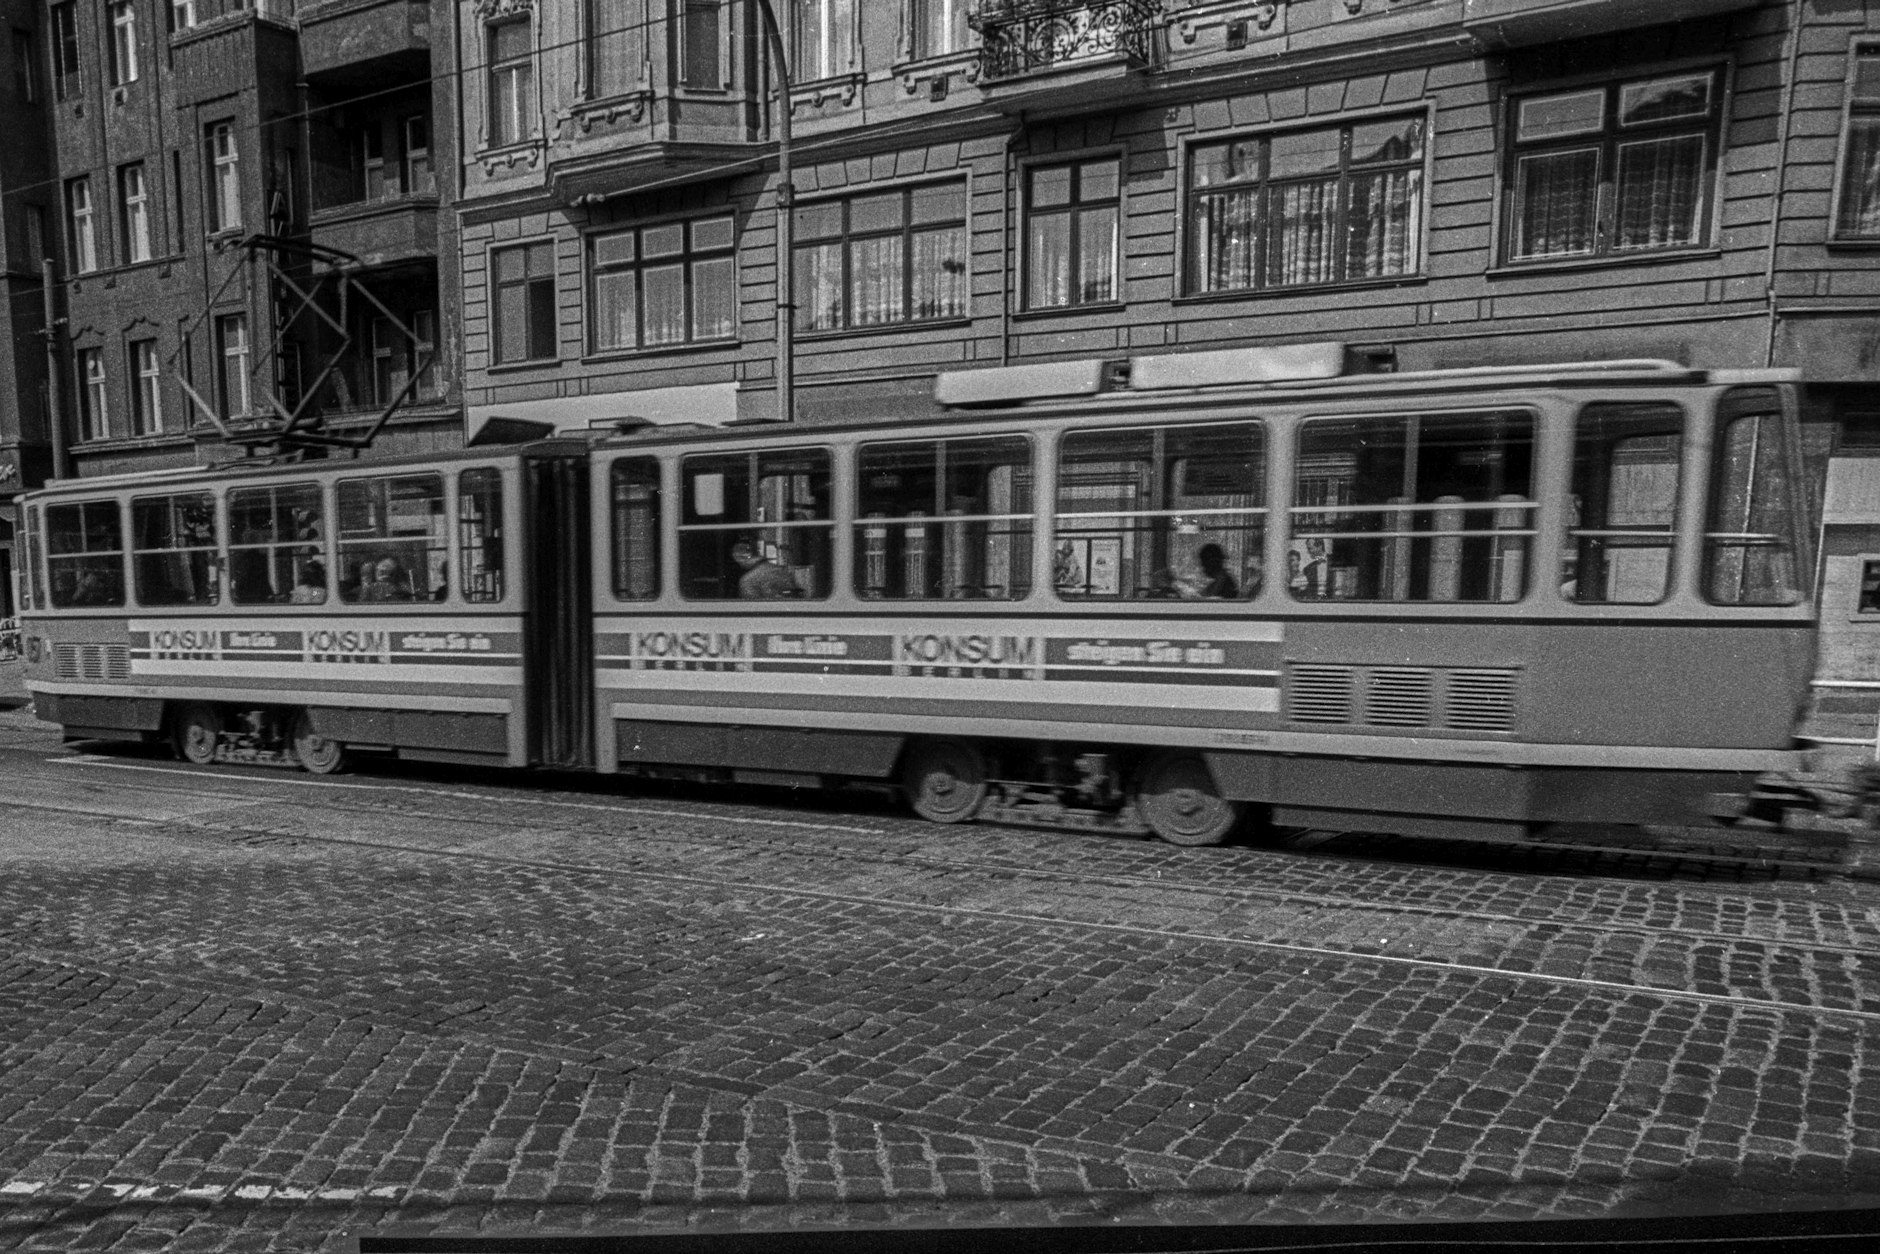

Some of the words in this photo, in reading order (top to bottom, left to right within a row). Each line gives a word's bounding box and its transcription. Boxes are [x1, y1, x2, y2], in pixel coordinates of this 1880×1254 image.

[154, 630, 217, 650] KONSUM
[307, 631, 386, 651] KONSUM
[636, 632, 745, 657] KONSUM
[900, 634, 1037, 664] KONSUM
